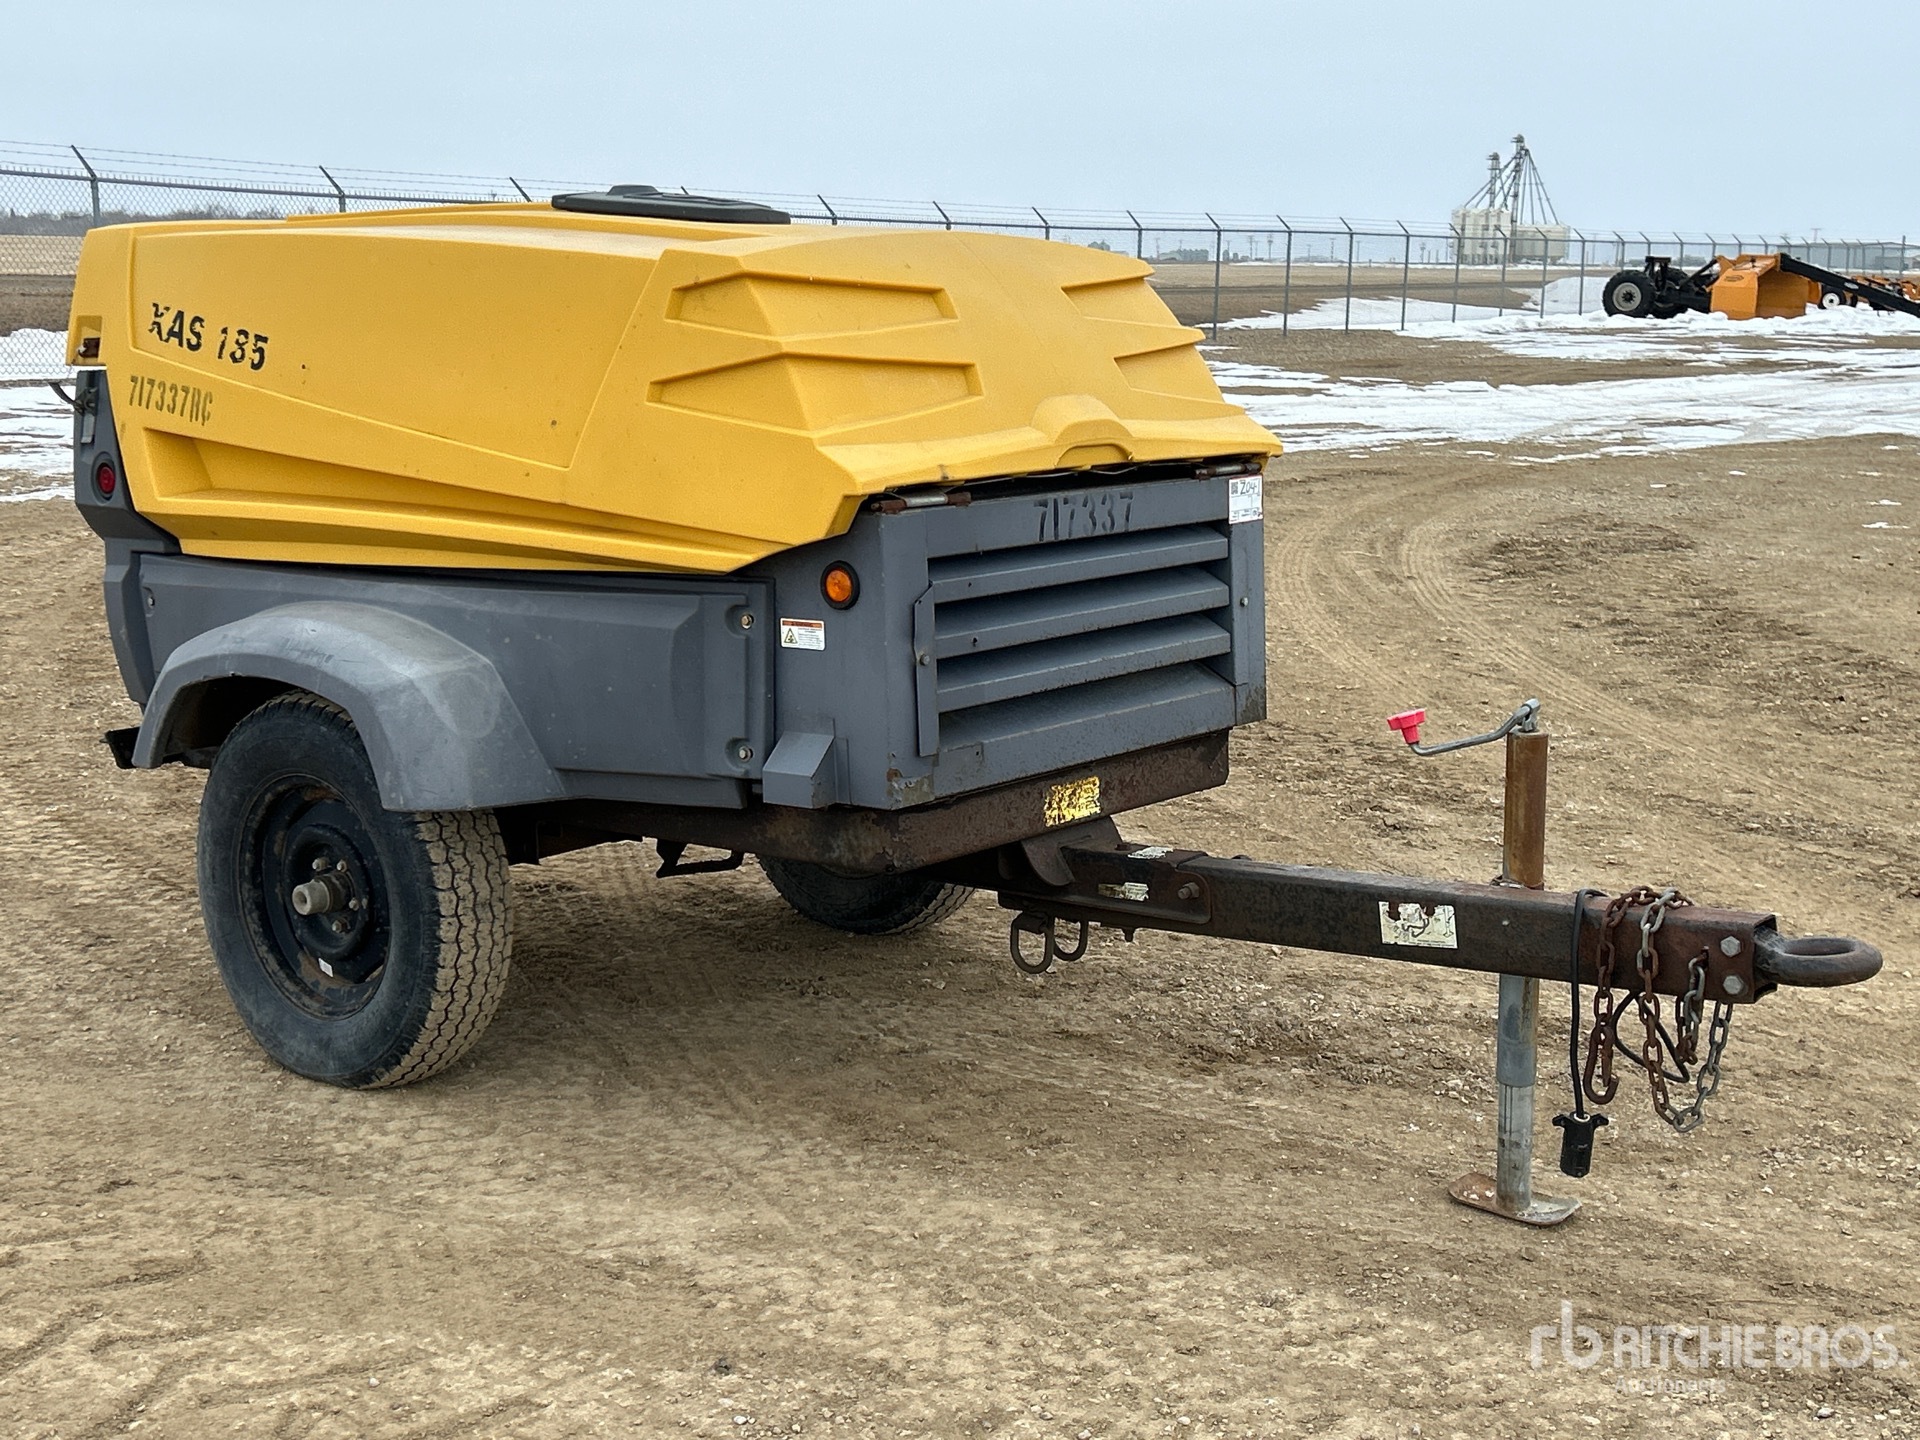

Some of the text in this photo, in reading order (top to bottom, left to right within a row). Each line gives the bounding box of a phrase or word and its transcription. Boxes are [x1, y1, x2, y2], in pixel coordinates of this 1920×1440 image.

[148, 302, 269, 371] XAS 185
[1033, 491, 1134, 542] 717337
